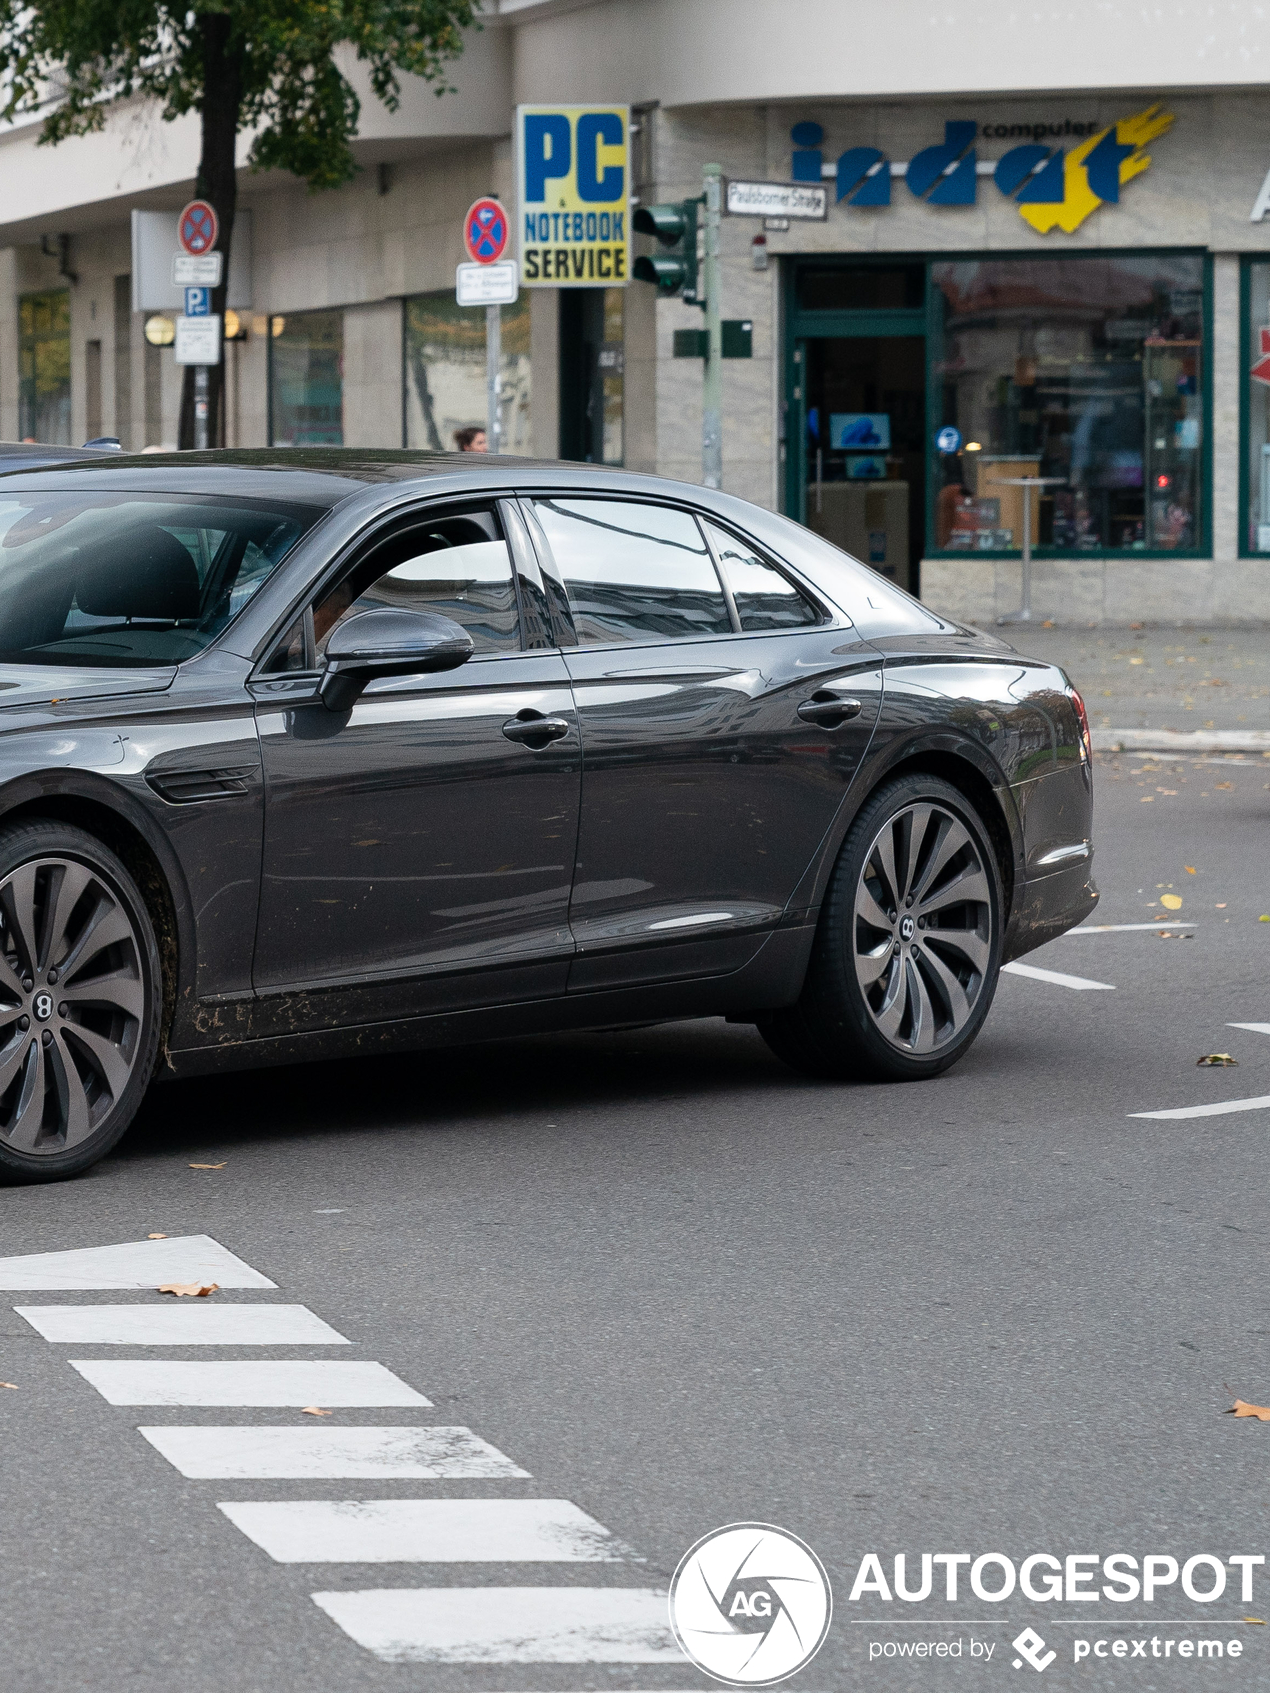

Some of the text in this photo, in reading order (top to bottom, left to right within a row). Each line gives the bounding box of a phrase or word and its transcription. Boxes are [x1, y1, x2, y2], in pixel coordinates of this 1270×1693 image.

[981, 118, 1098, 141] computer
[524, 113, 624, 203] PC
[525, 212, 625, 242] NOTEBOOK
[525, 249, 625, 278] SERVICE
[188, 289, 203, 315] P
